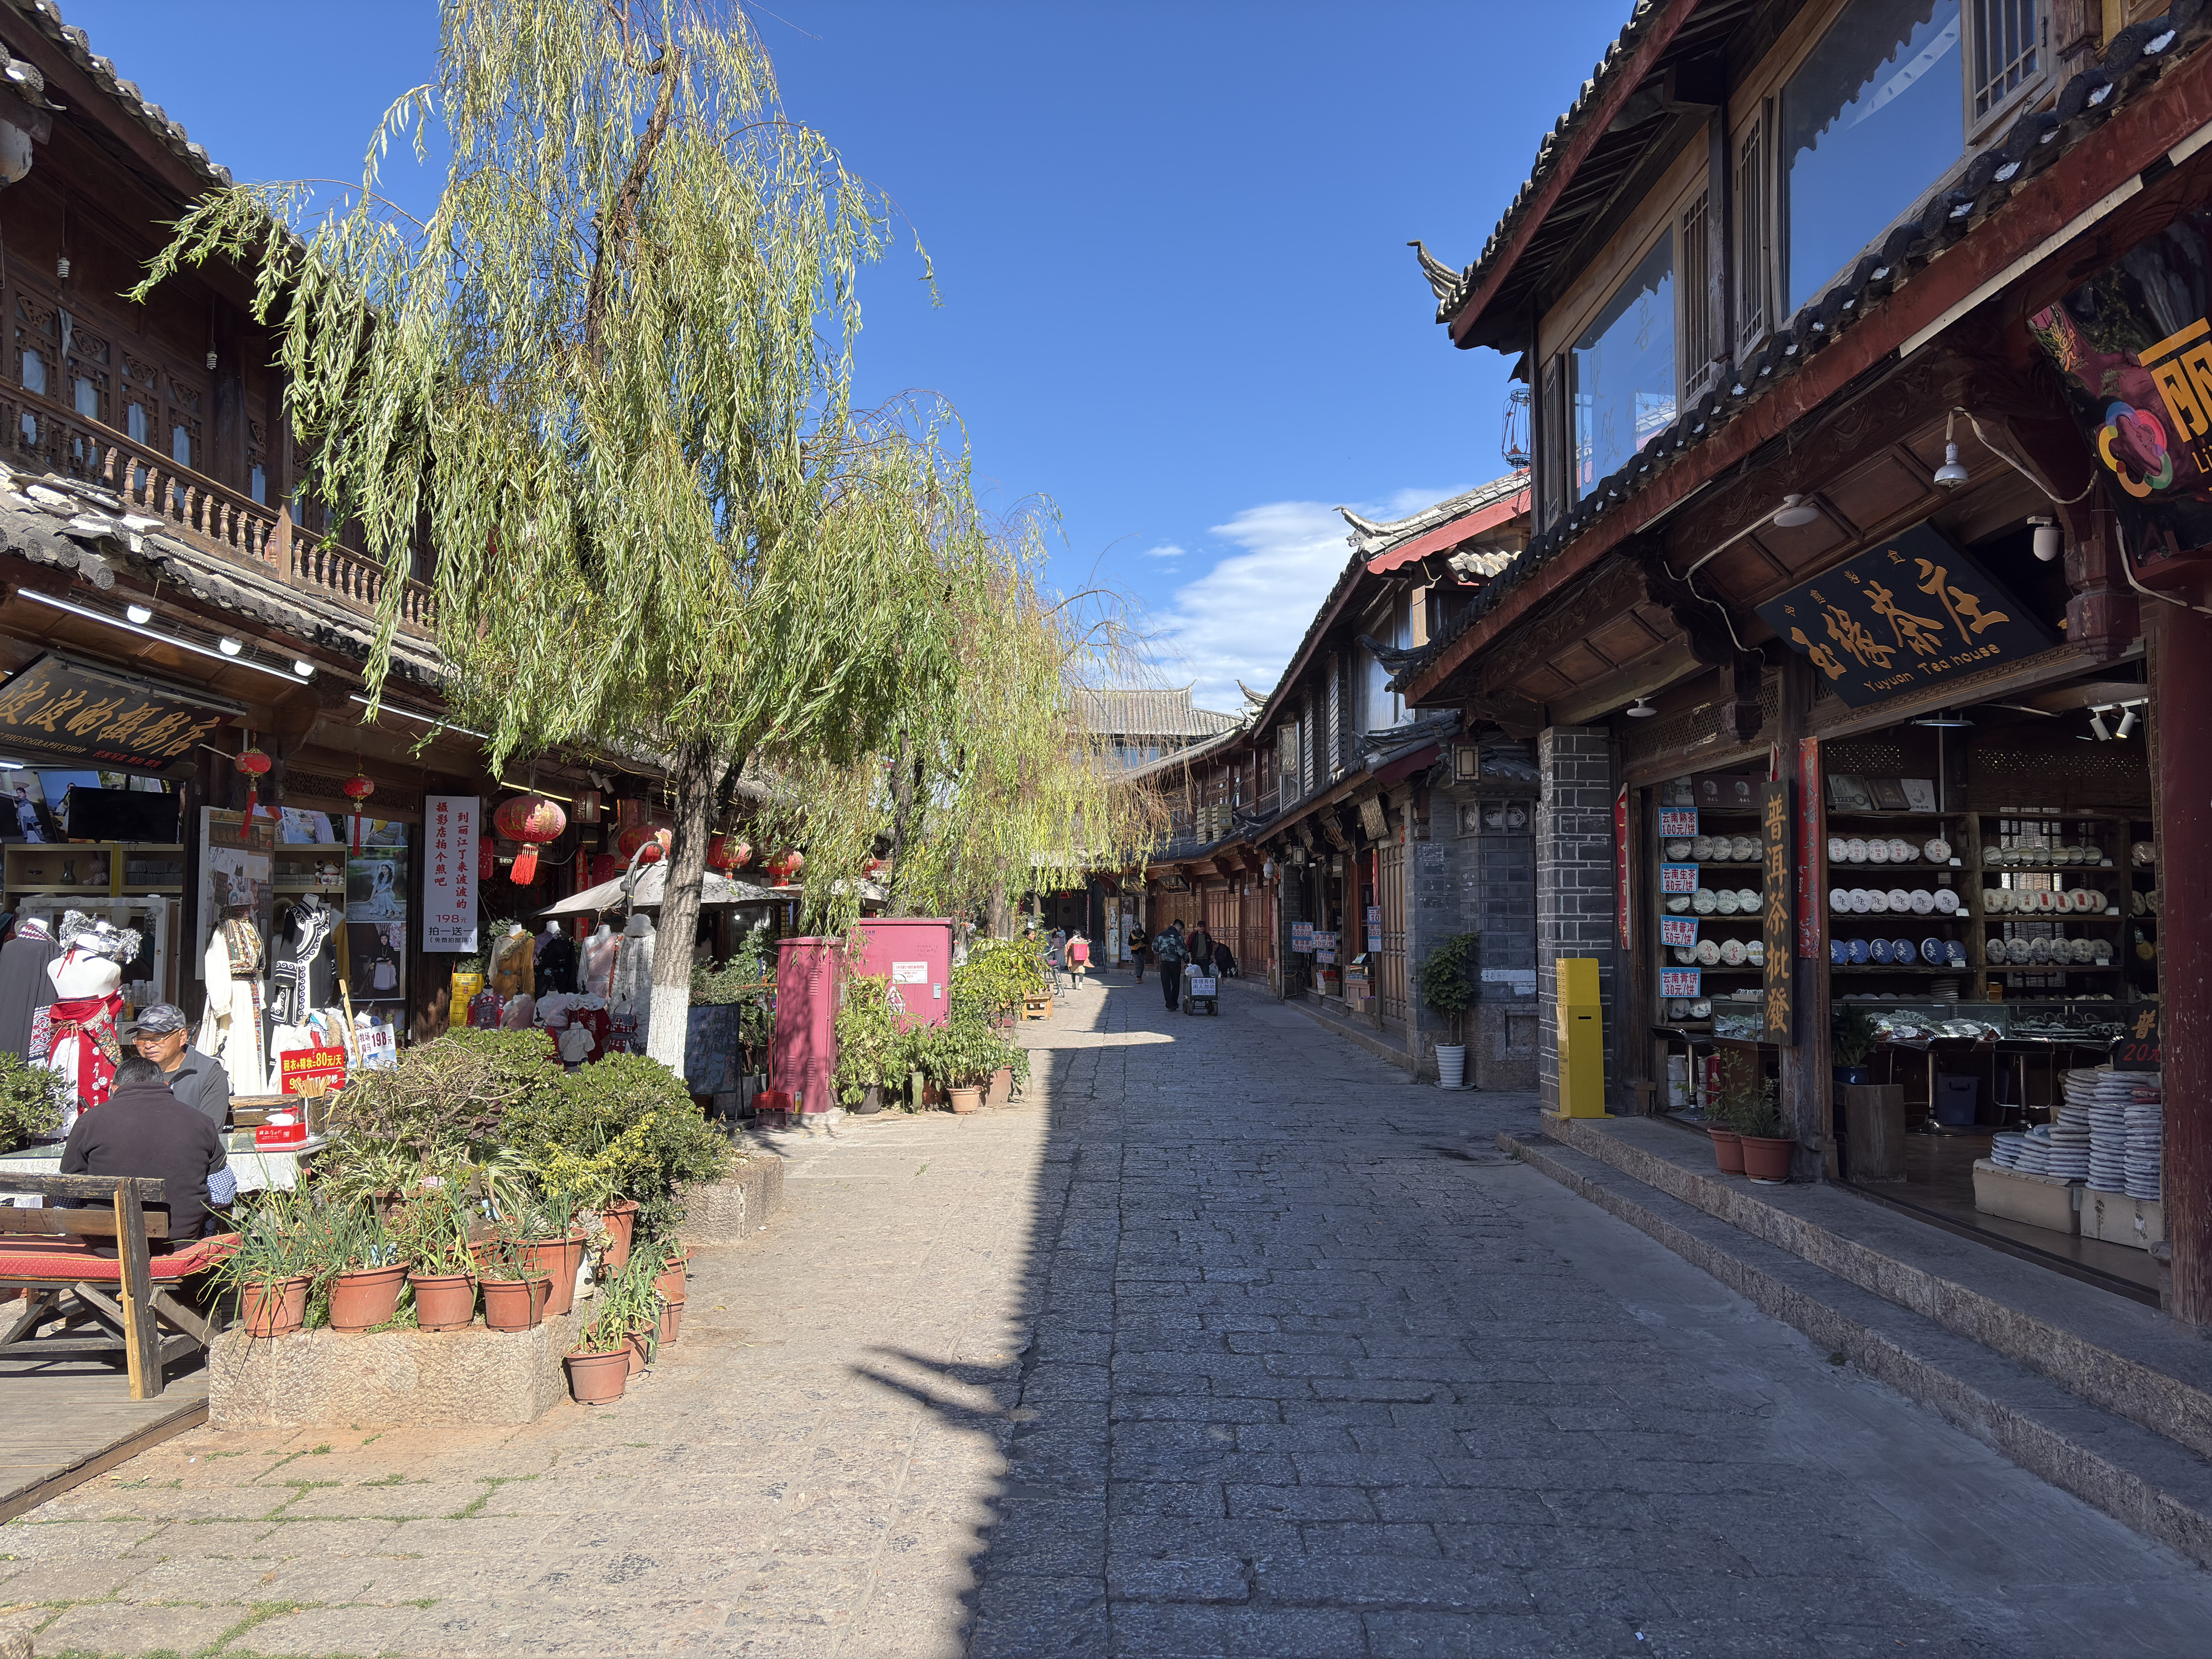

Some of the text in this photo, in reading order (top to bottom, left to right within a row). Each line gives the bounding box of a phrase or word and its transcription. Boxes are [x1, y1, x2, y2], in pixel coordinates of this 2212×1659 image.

[2192, 445, 2212, 473] Li
[1864, 643, 2001, 692] Yuyuan Tea house
[1662, 812, 1695, 823] 云南熟茶
[1662, 823, 1695, 836] 100元/饼
[434, 802, 449, 886] 摄影店拍个照吧
[455, 812, 469, 909] 到丽江了来波波的
[1663, 869, 1695, 880] 云南生茶
[1666, 880, 1693, 892] 80元/饼
[435, 914, 467, 924] 198元
[429, 926, 474, 936] 拍一送一
[1663, 921, 1695, 934] 云南普洱
[1665, 932, 1692, 945] 50元/饼
[1663, 973, 1698, 984] 云南青饼
[1666, 984, 1694, 996] 30元/饼
[372, 1031, 393, 1047] 198元
[283, 1052, 342, 1072] 租衣+精妆=80元/天
